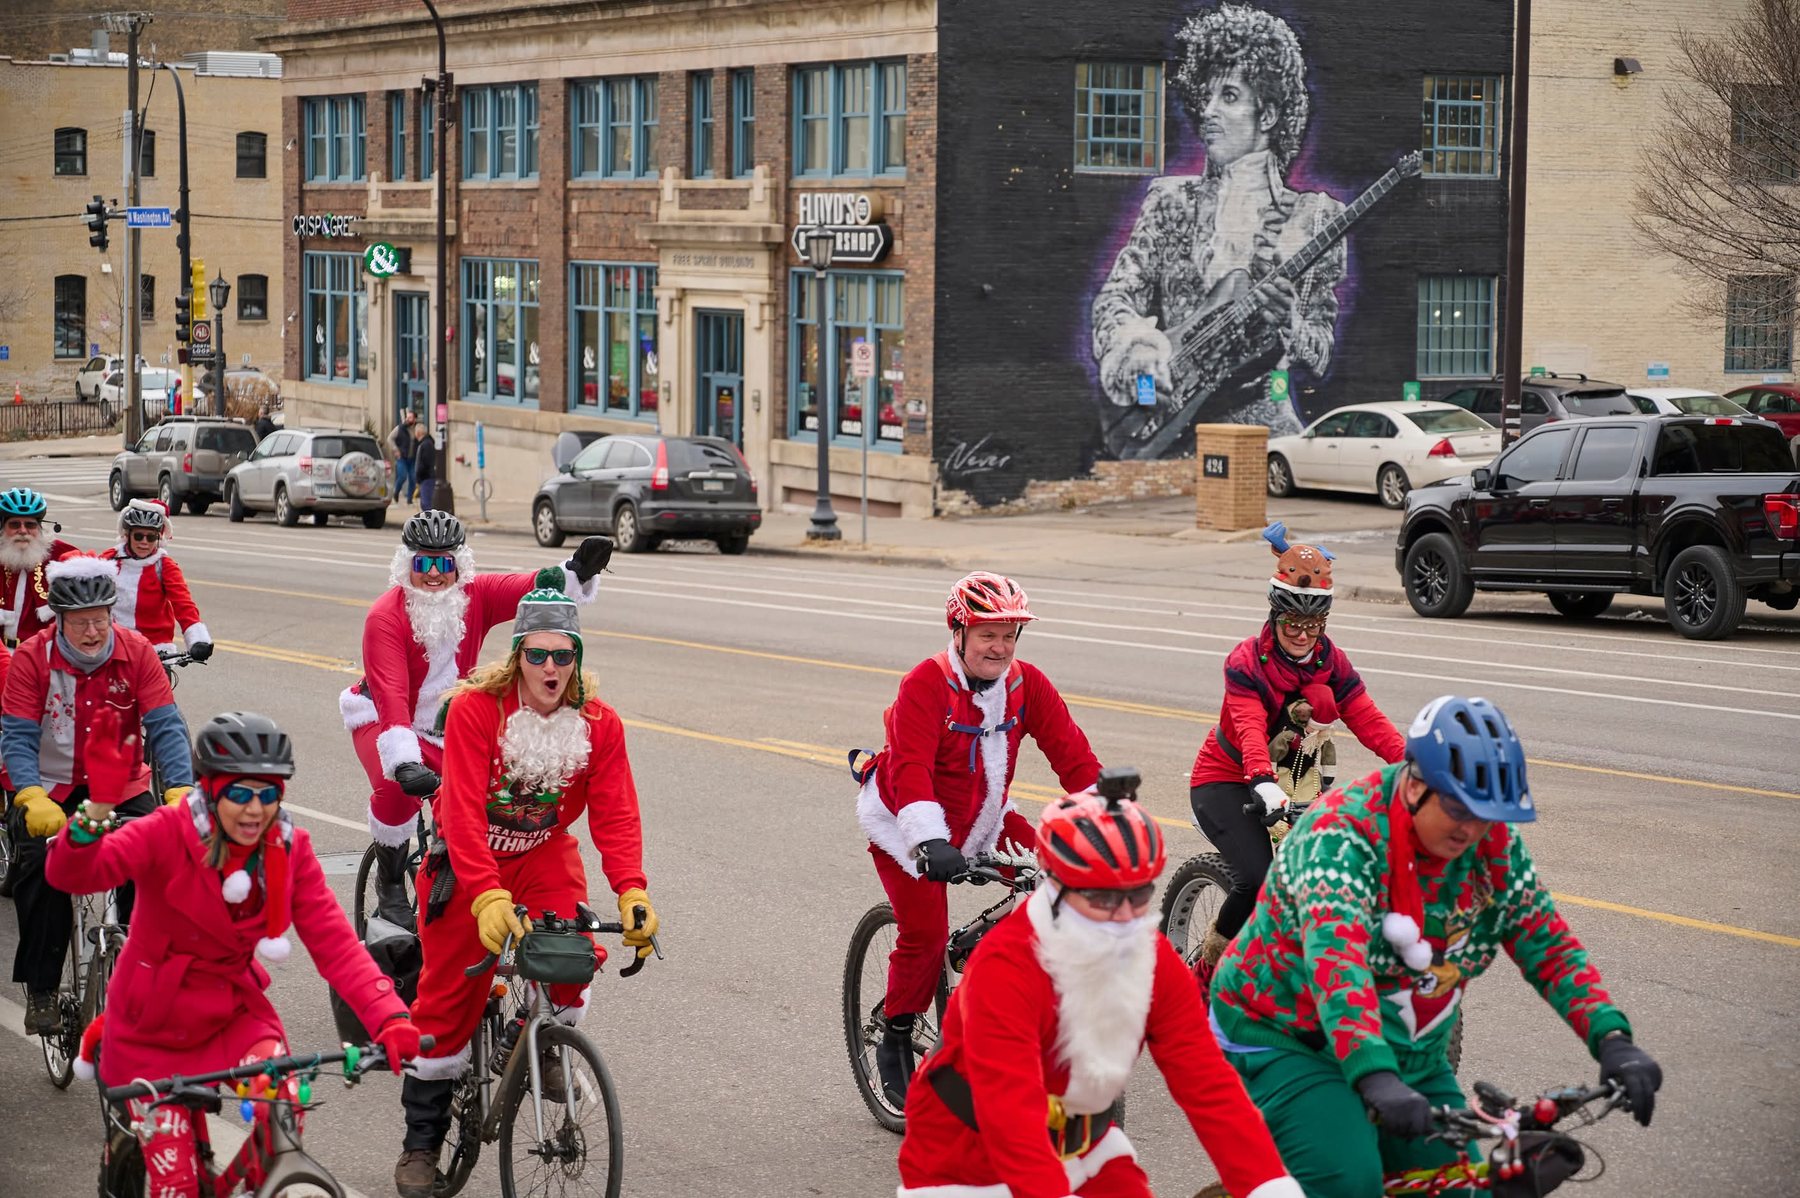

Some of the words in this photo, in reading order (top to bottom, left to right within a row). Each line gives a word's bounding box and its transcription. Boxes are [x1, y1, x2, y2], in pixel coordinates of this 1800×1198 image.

[133, 211, 161, 226] Washington
[799, 193, 856, 225] FLOYD'S
[799, 231, 875, 251] BRSHOP
[370, 244, 399, 273] &
[1206, 458, 1223, 474] 424
[486, 830, 552, 853] ITHMAS
[489, 824, 501, 834] VE
[510, 830, 539, 838] HOLLY
[150, 1147, 178, 1176] Ho
